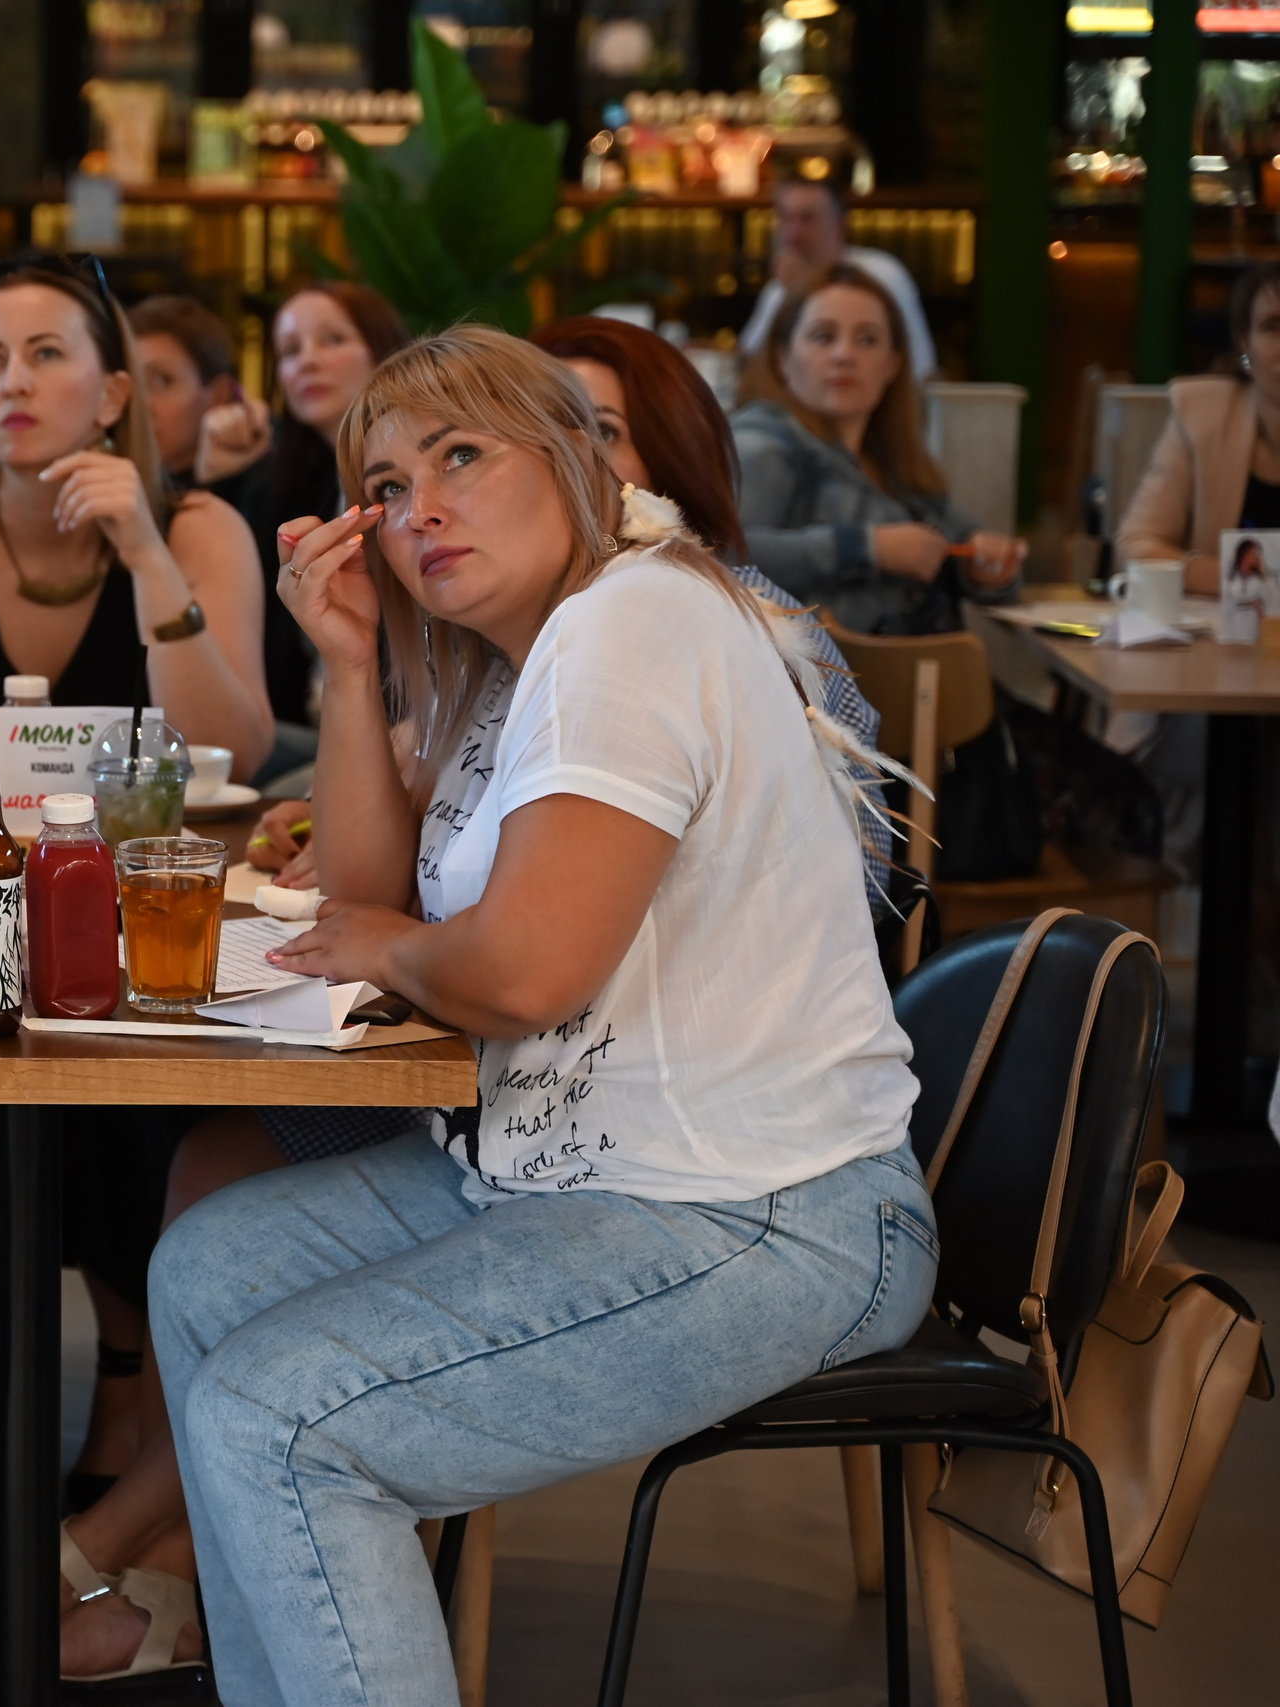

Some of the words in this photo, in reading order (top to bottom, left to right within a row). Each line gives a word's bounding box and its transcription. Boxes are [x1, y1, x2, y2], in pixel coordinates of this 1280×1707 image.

[30, 762, 75, 774] КОМАНДА
[487, 1062, 565, 1108] greater
[504, 1097, 557, 1139] that
[598, 1133, 617, 1152] a
